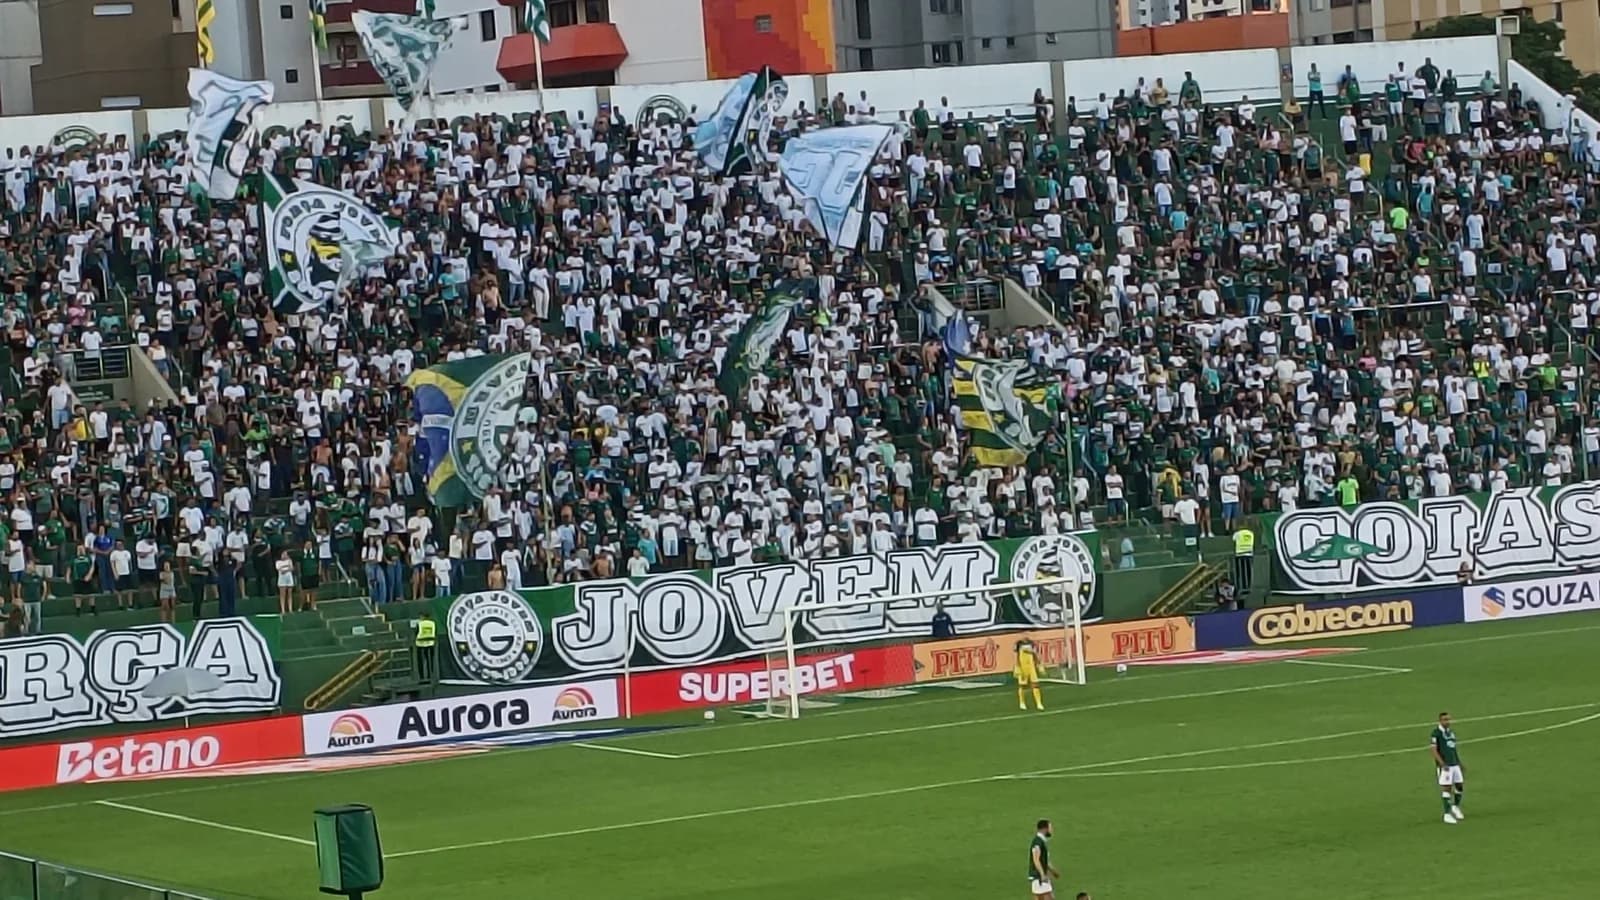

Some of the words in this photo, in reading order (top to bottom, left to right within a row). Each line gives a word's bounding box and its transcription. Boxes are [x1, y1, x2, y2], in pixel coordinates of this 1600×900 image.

[556, 546, 996, 666] JOVEM
[1512, 581, 1595, 611] SOUZA
[475, 616, 514, 656] G
[1258, 600, 1413, 637] cobrecom
[679, 653, 856, 702] SUPERBET
[398, 699, 530, 740] Aurora
[551, 706, 597, 721] Aurora
[56, 735, 220, 784] Betano
[327, 733, 374, 748] Aurora
